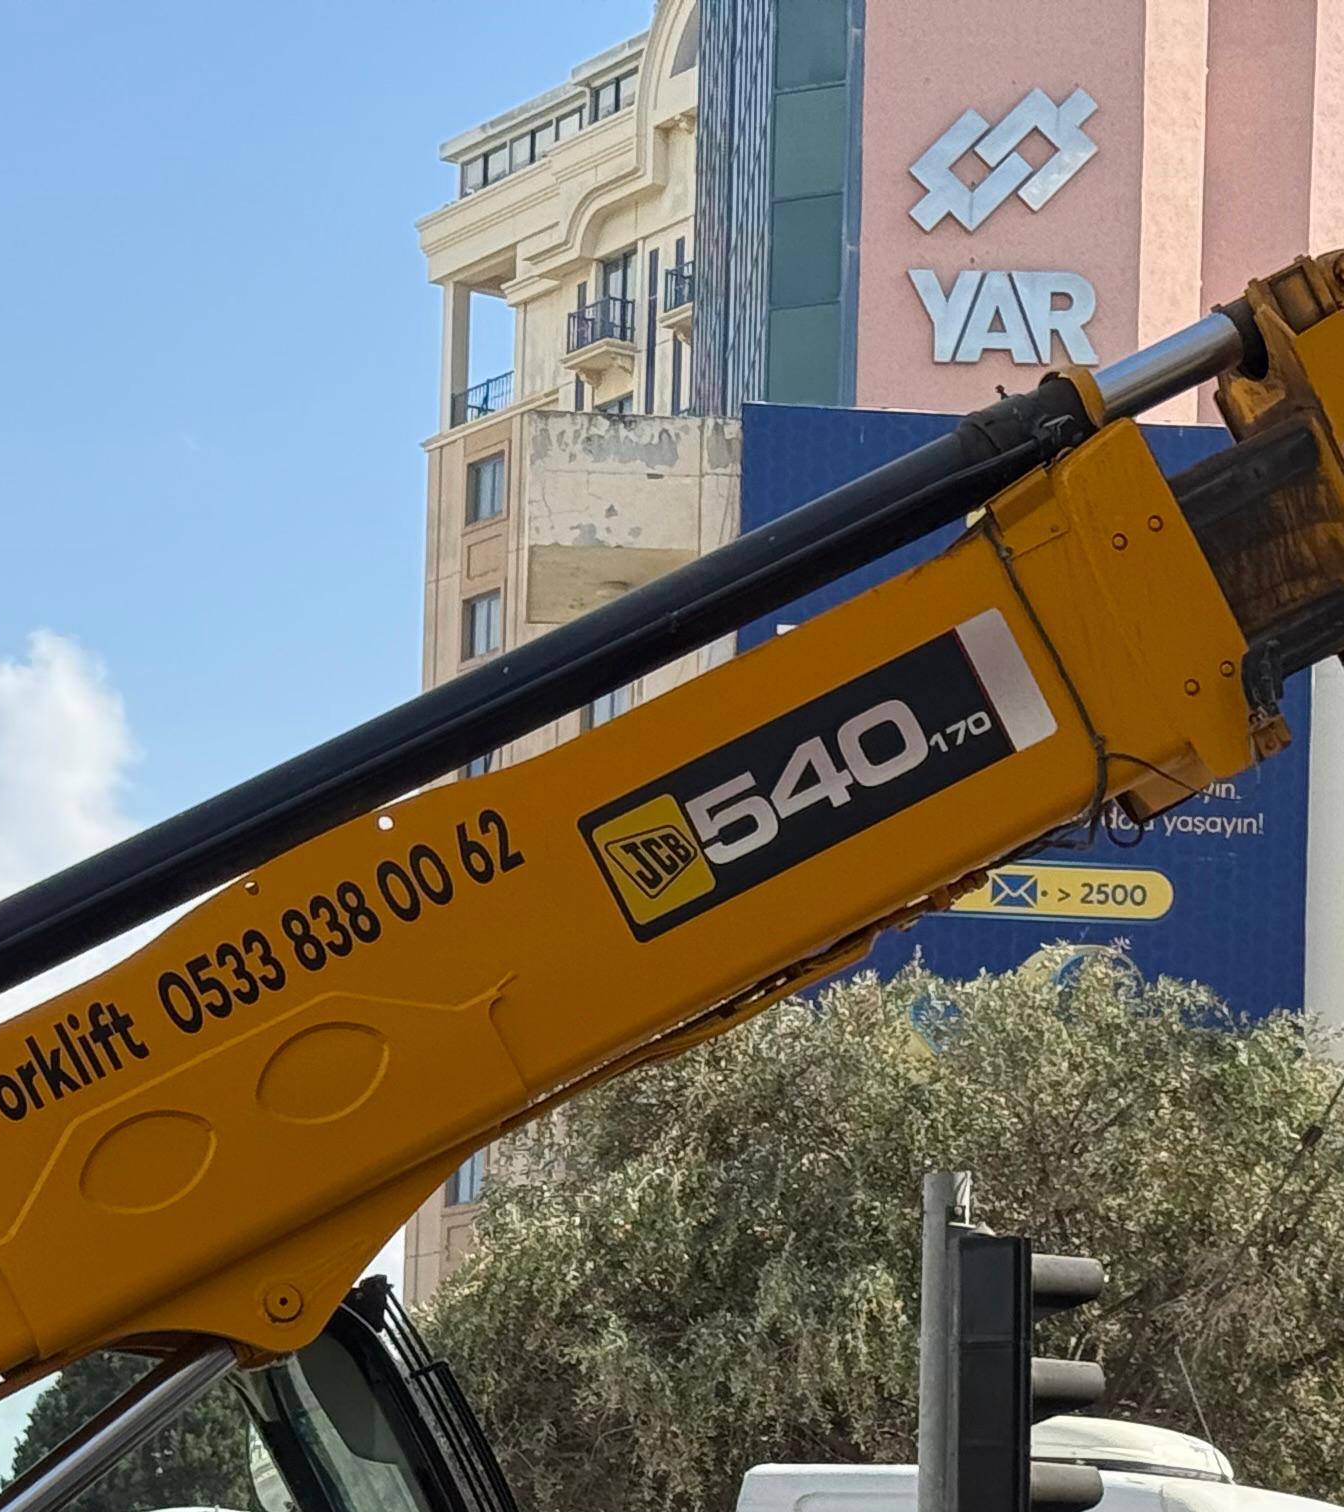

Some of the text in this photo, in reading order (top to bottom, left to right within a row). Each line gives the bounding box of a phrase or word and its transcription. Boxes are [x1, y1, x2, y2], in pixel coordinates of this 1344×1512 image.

[908, 269, 1099, 365] YAR
[685, 700, 992, 865] 540 170
[624, 828, 693, 892] JCB
[1162, 813, 1264, 838] yaşayın!
[158, 929, 287, 1034] 0533
[281, 881, 382, 971] 838
[376, 844, 454, 922] 00
[457, 810, 525, 884] 62
[1080, 881, 1147, 906] 2500
